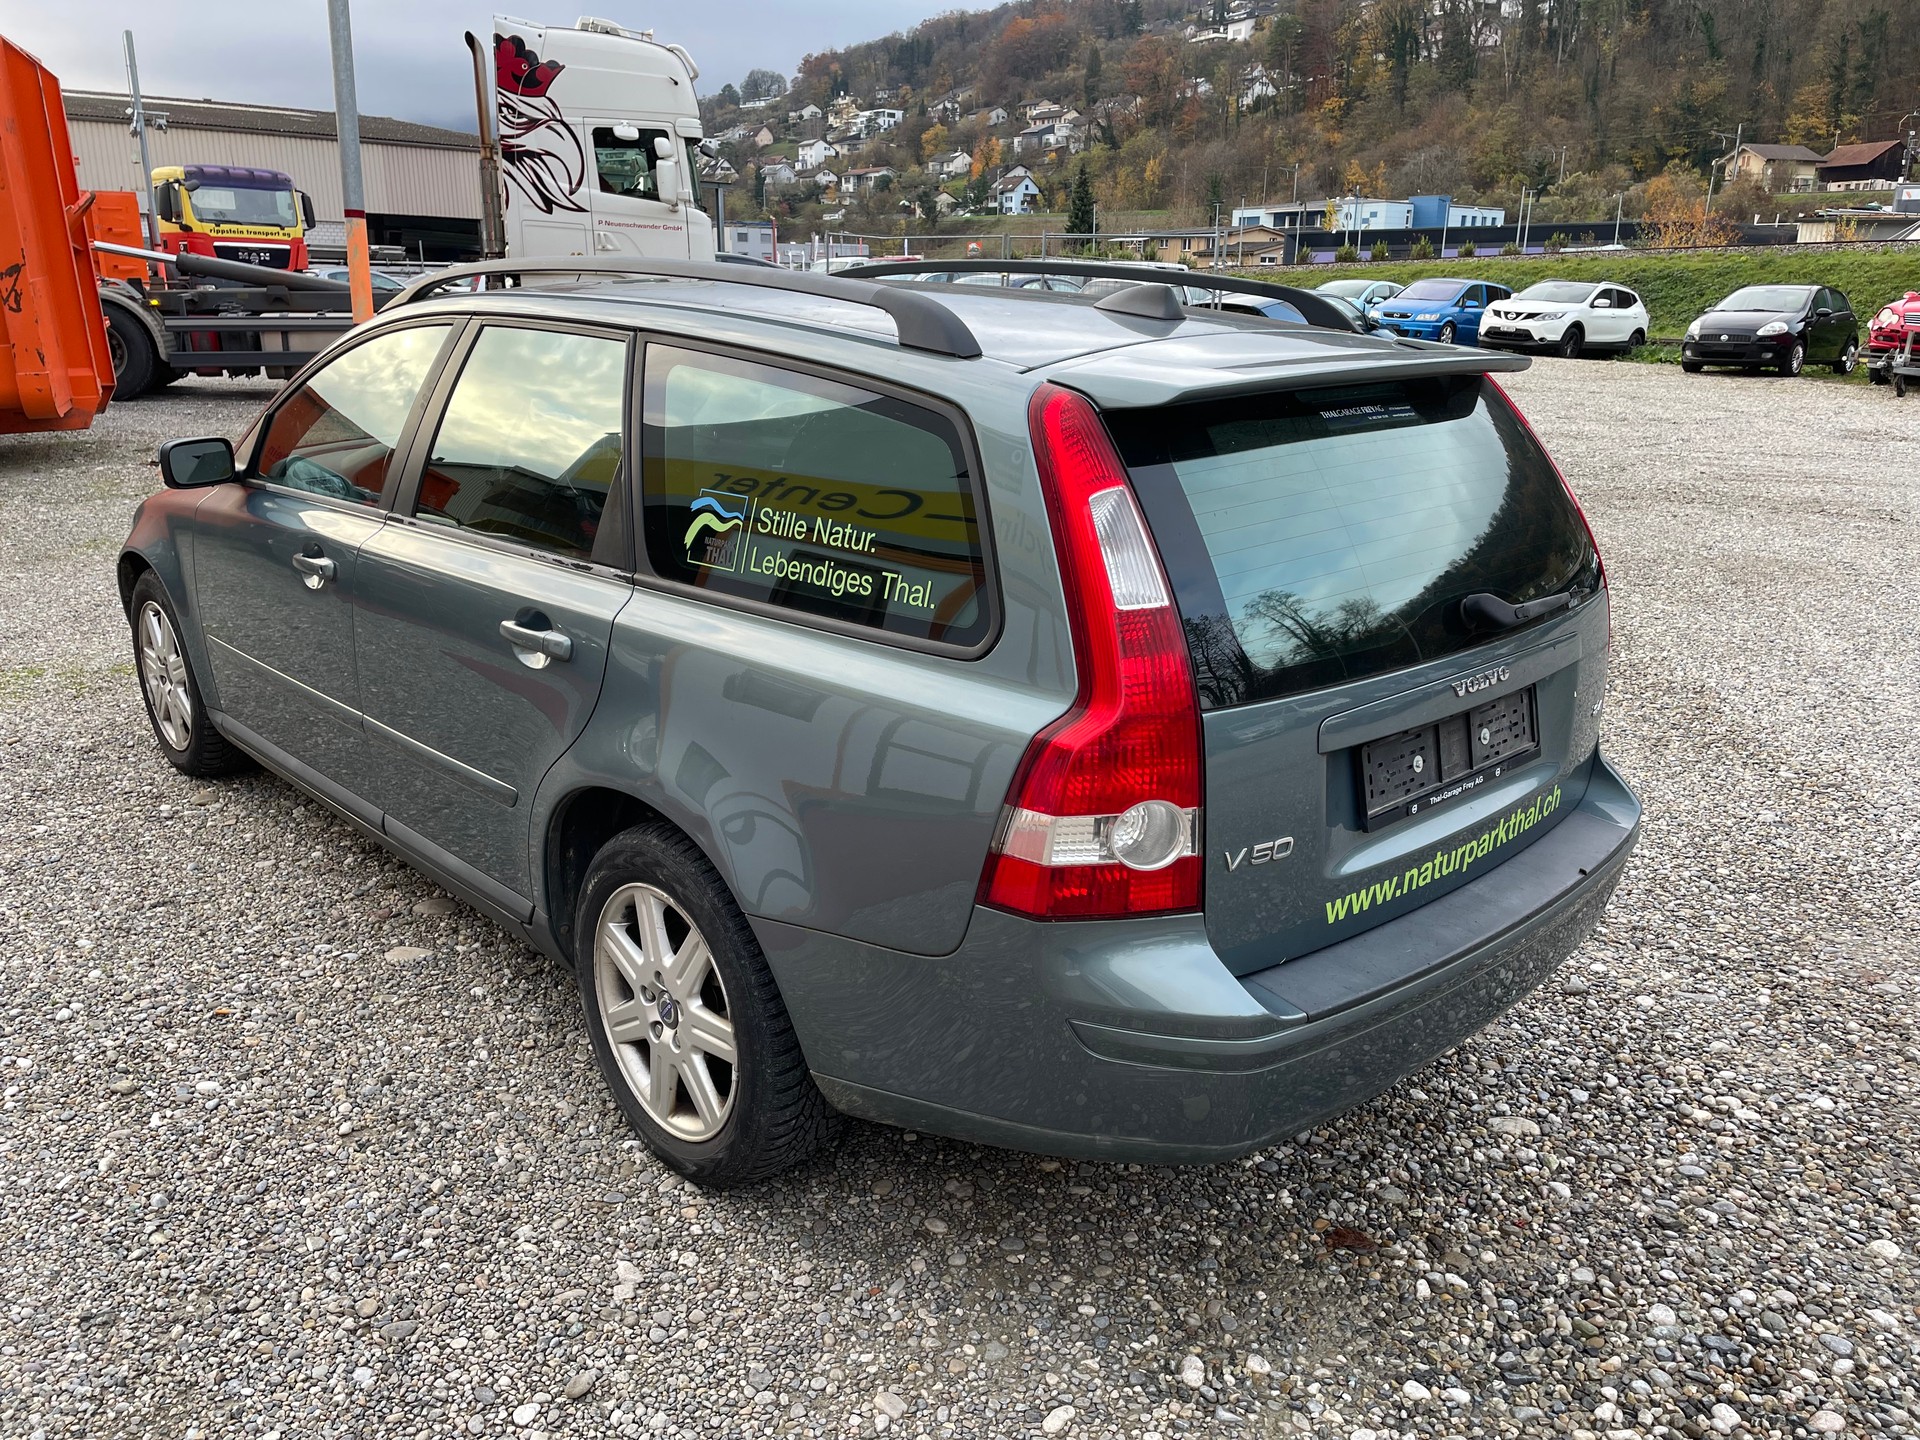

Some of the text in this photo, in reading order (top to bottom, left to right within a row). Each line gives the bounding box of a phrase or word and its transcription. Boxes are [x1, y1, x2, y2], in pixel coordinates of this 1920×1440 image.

[209, 227, 244, 235] rippstein
[604, 220, 661, 230] Neuenschwander
[238, 251, 270, 261] MAN
[757, 507, 877, 553] Stille Natur.
[704, 536, 737, 551] NATURPARK
[706, 546, 734, 567] THAL
[750, 546, 936, 609] Lebendiges Thal.
[1451, 665, 1510, 697] VOLVO
[1429, 775, 1484, 805] Thal-Garage Frey AG
[1325, 784, 1562, 924] www.naturparkthal.ch
